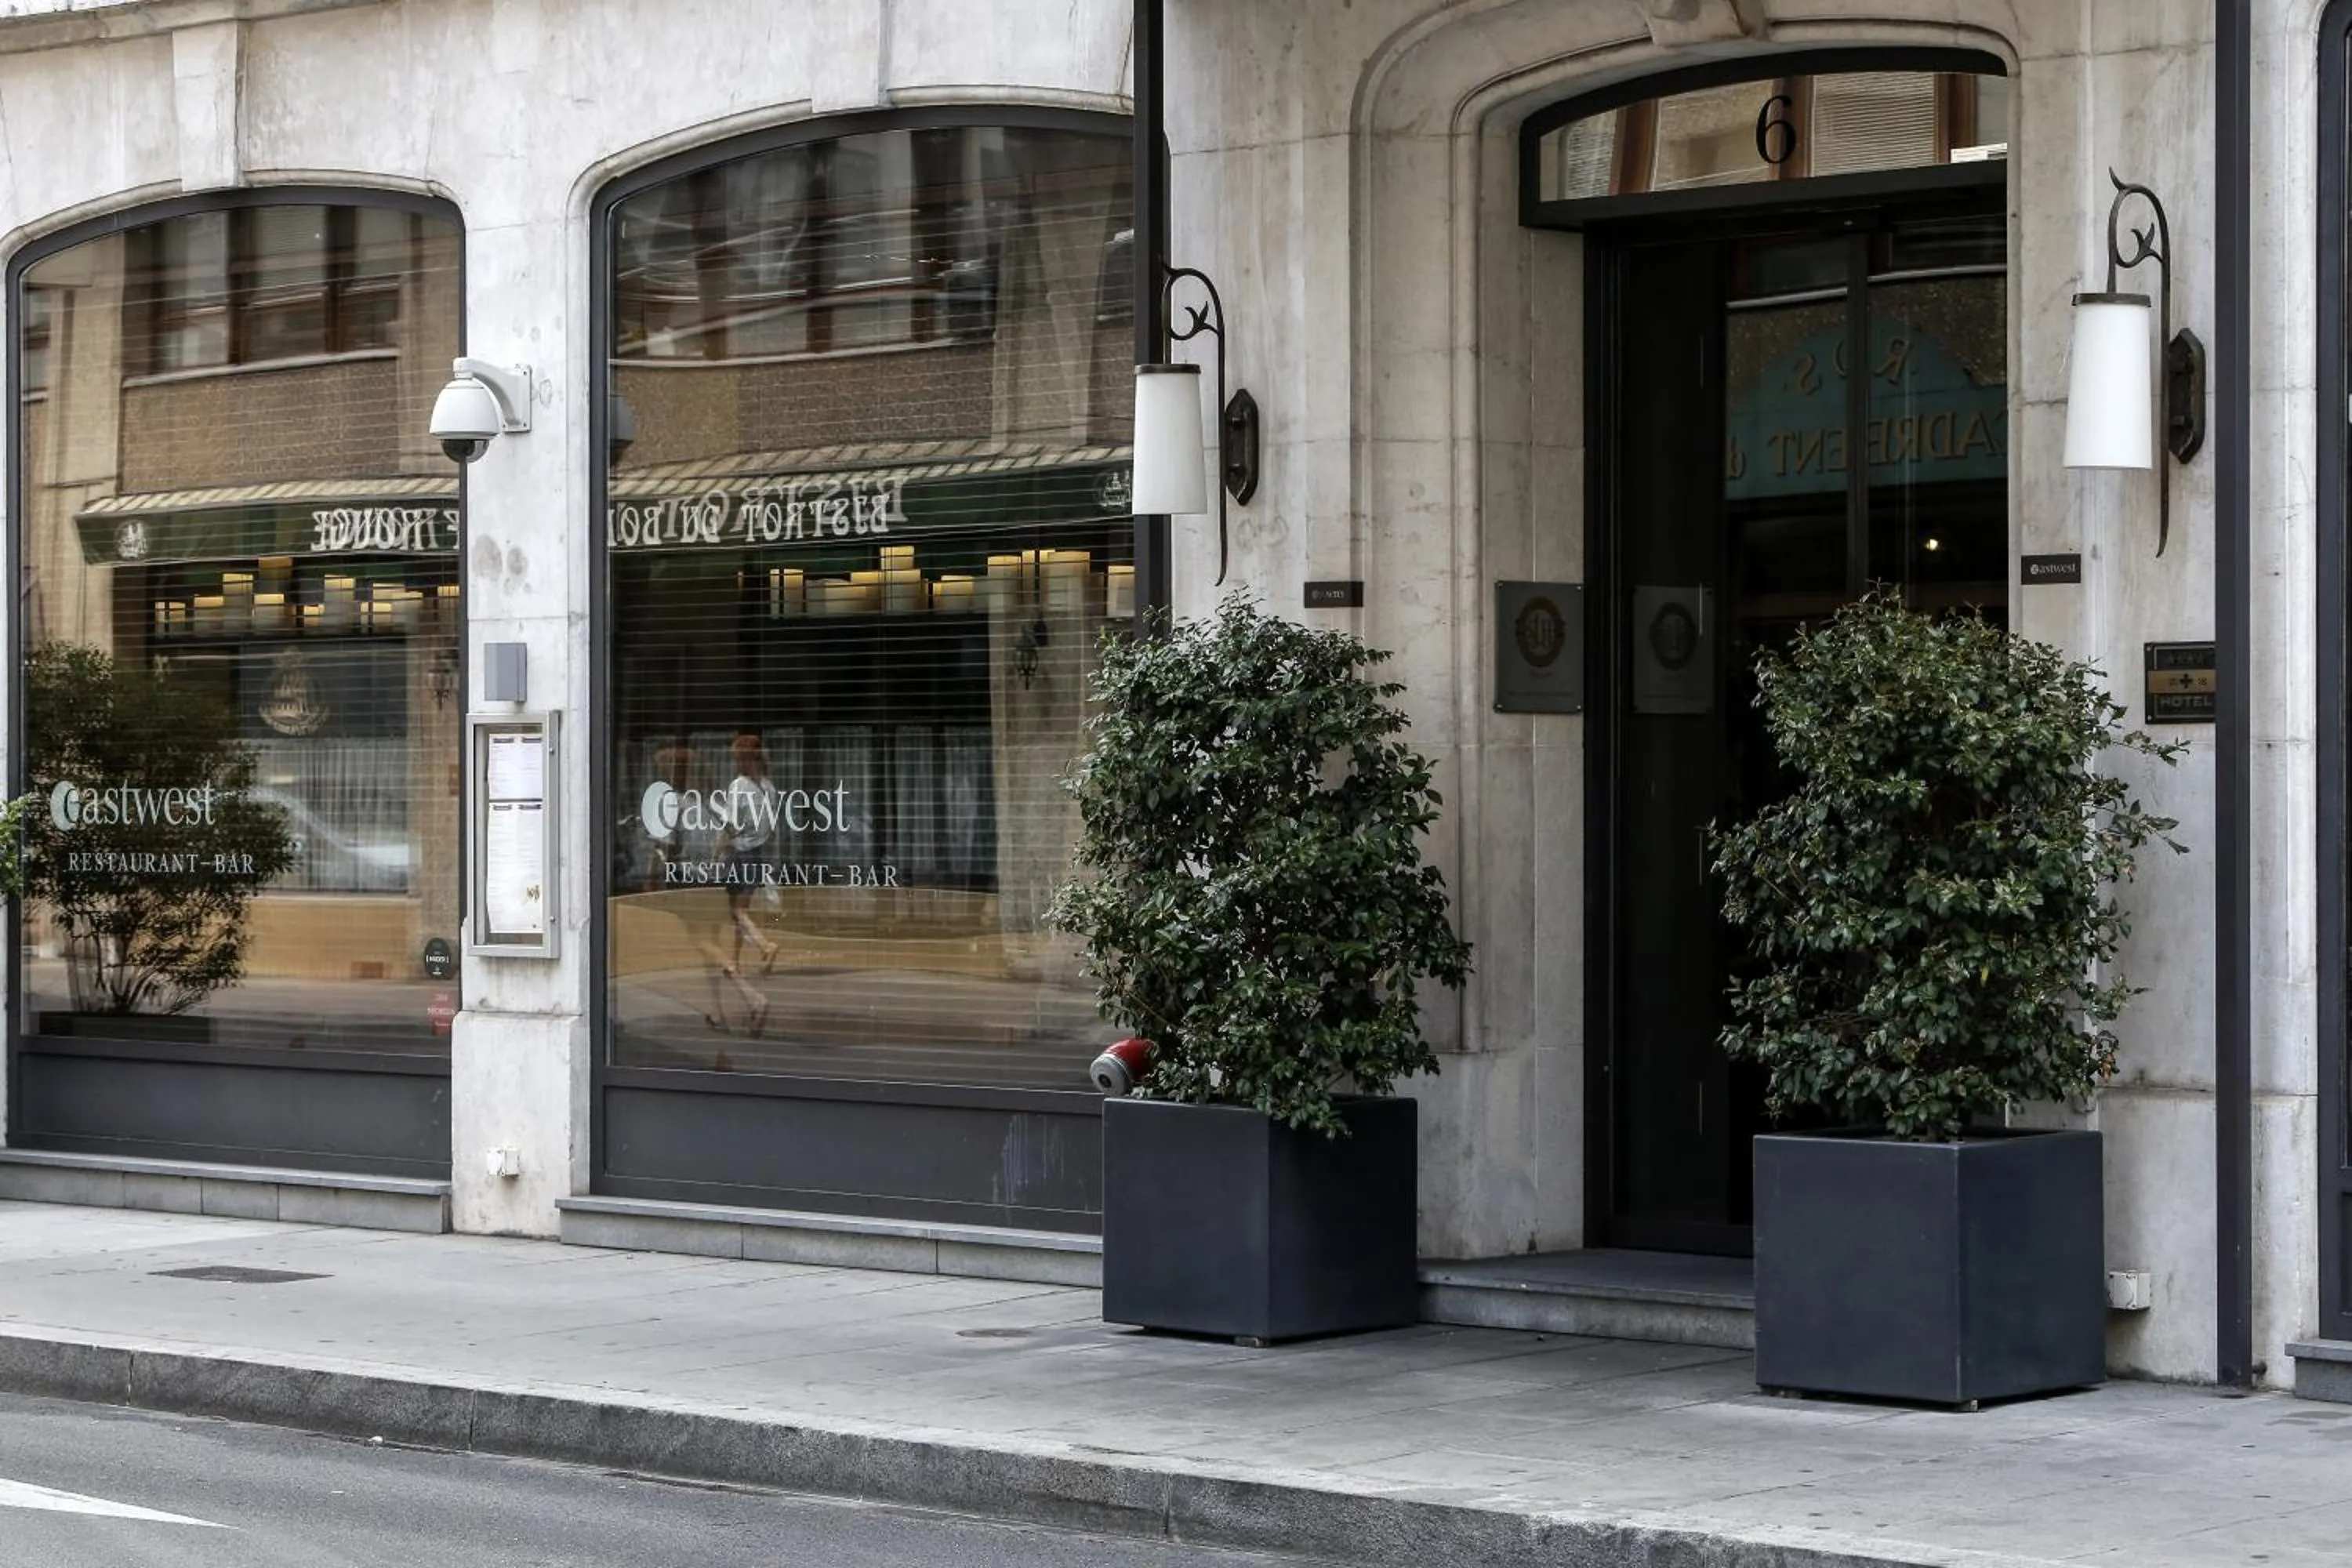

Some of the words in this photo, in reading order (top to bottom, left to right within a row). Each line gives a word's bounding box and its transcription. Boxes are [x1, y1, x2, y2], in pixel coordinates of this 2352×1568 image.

[1755, 95, 1796, 164] 6
[2160, 695, 2212, 708] HOTEL
[50, 779, 216, 831] eastwest
[641, 779, 851, 839] eastwest
